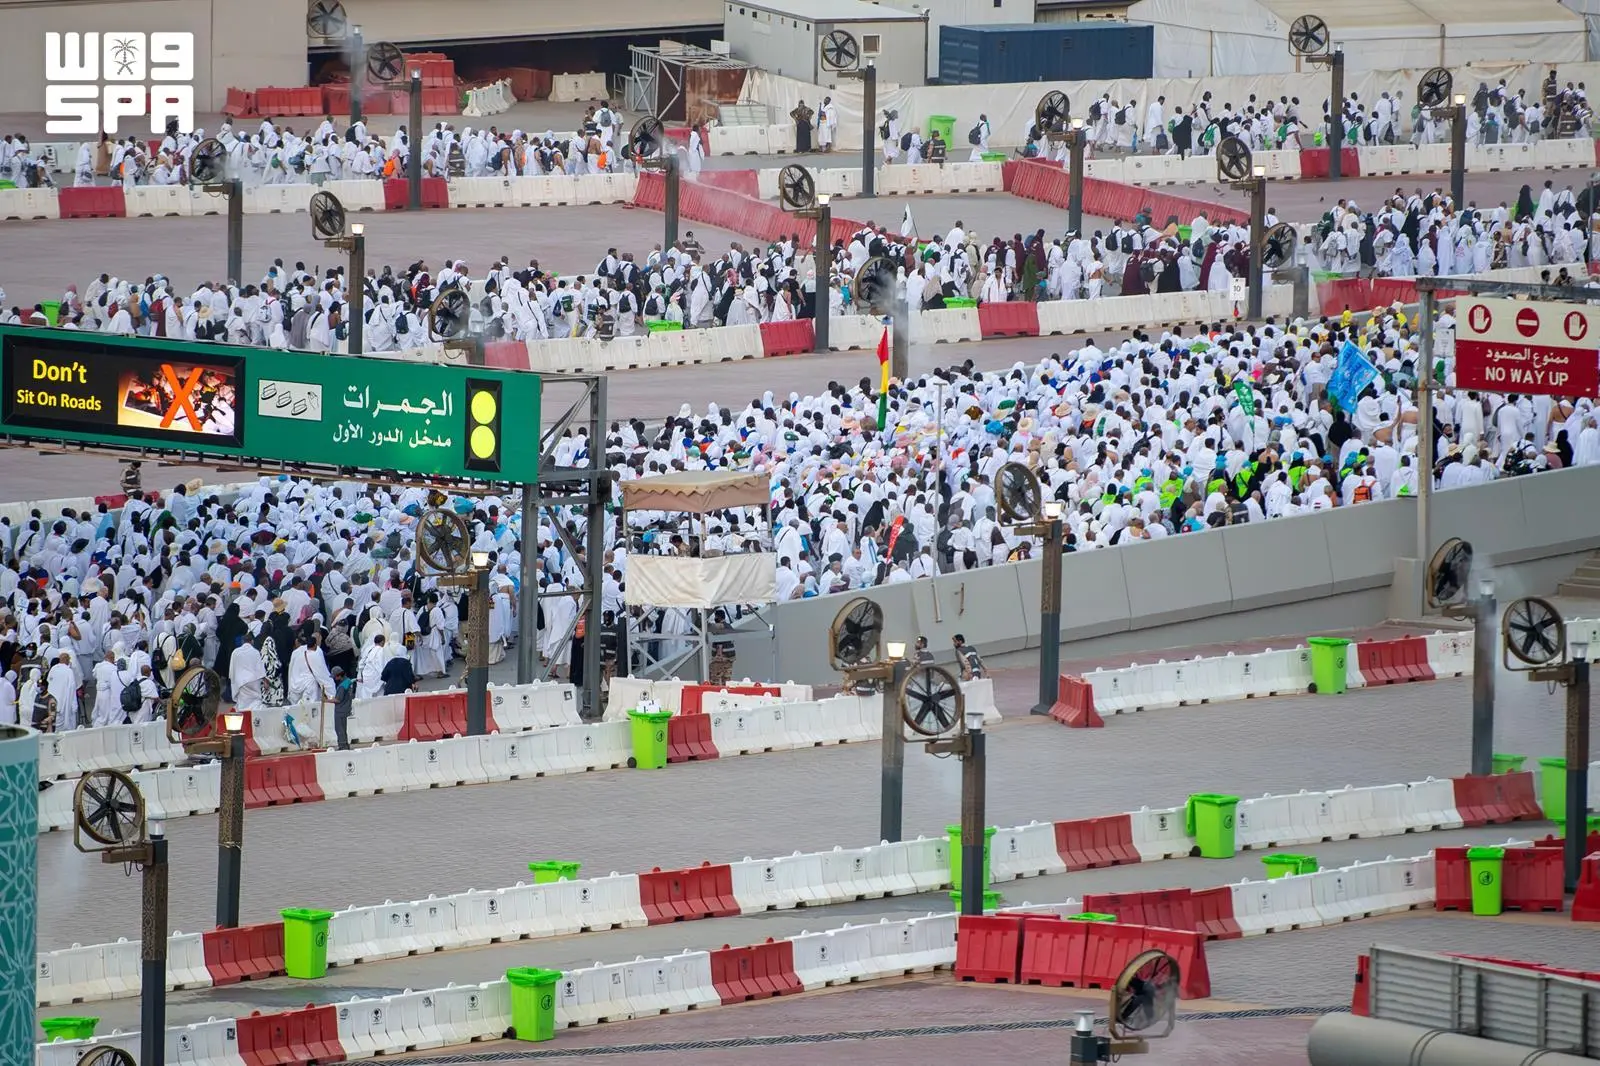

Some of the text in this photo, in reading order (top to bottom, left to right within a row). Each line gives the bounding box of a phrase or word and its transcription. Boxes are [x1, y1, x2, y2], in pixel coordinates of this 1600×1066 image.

[1486, 348, 1569, 368] ممنوع الصعود
[1485, 366, 1569, 386] NO WAY UP
[17, 389, 102, 411] Sit On Roads
[343, 385, 453, 424] الجمرات
[368, 429, 403, 445] الدور
[409, 429, 452, 448] مدخل
